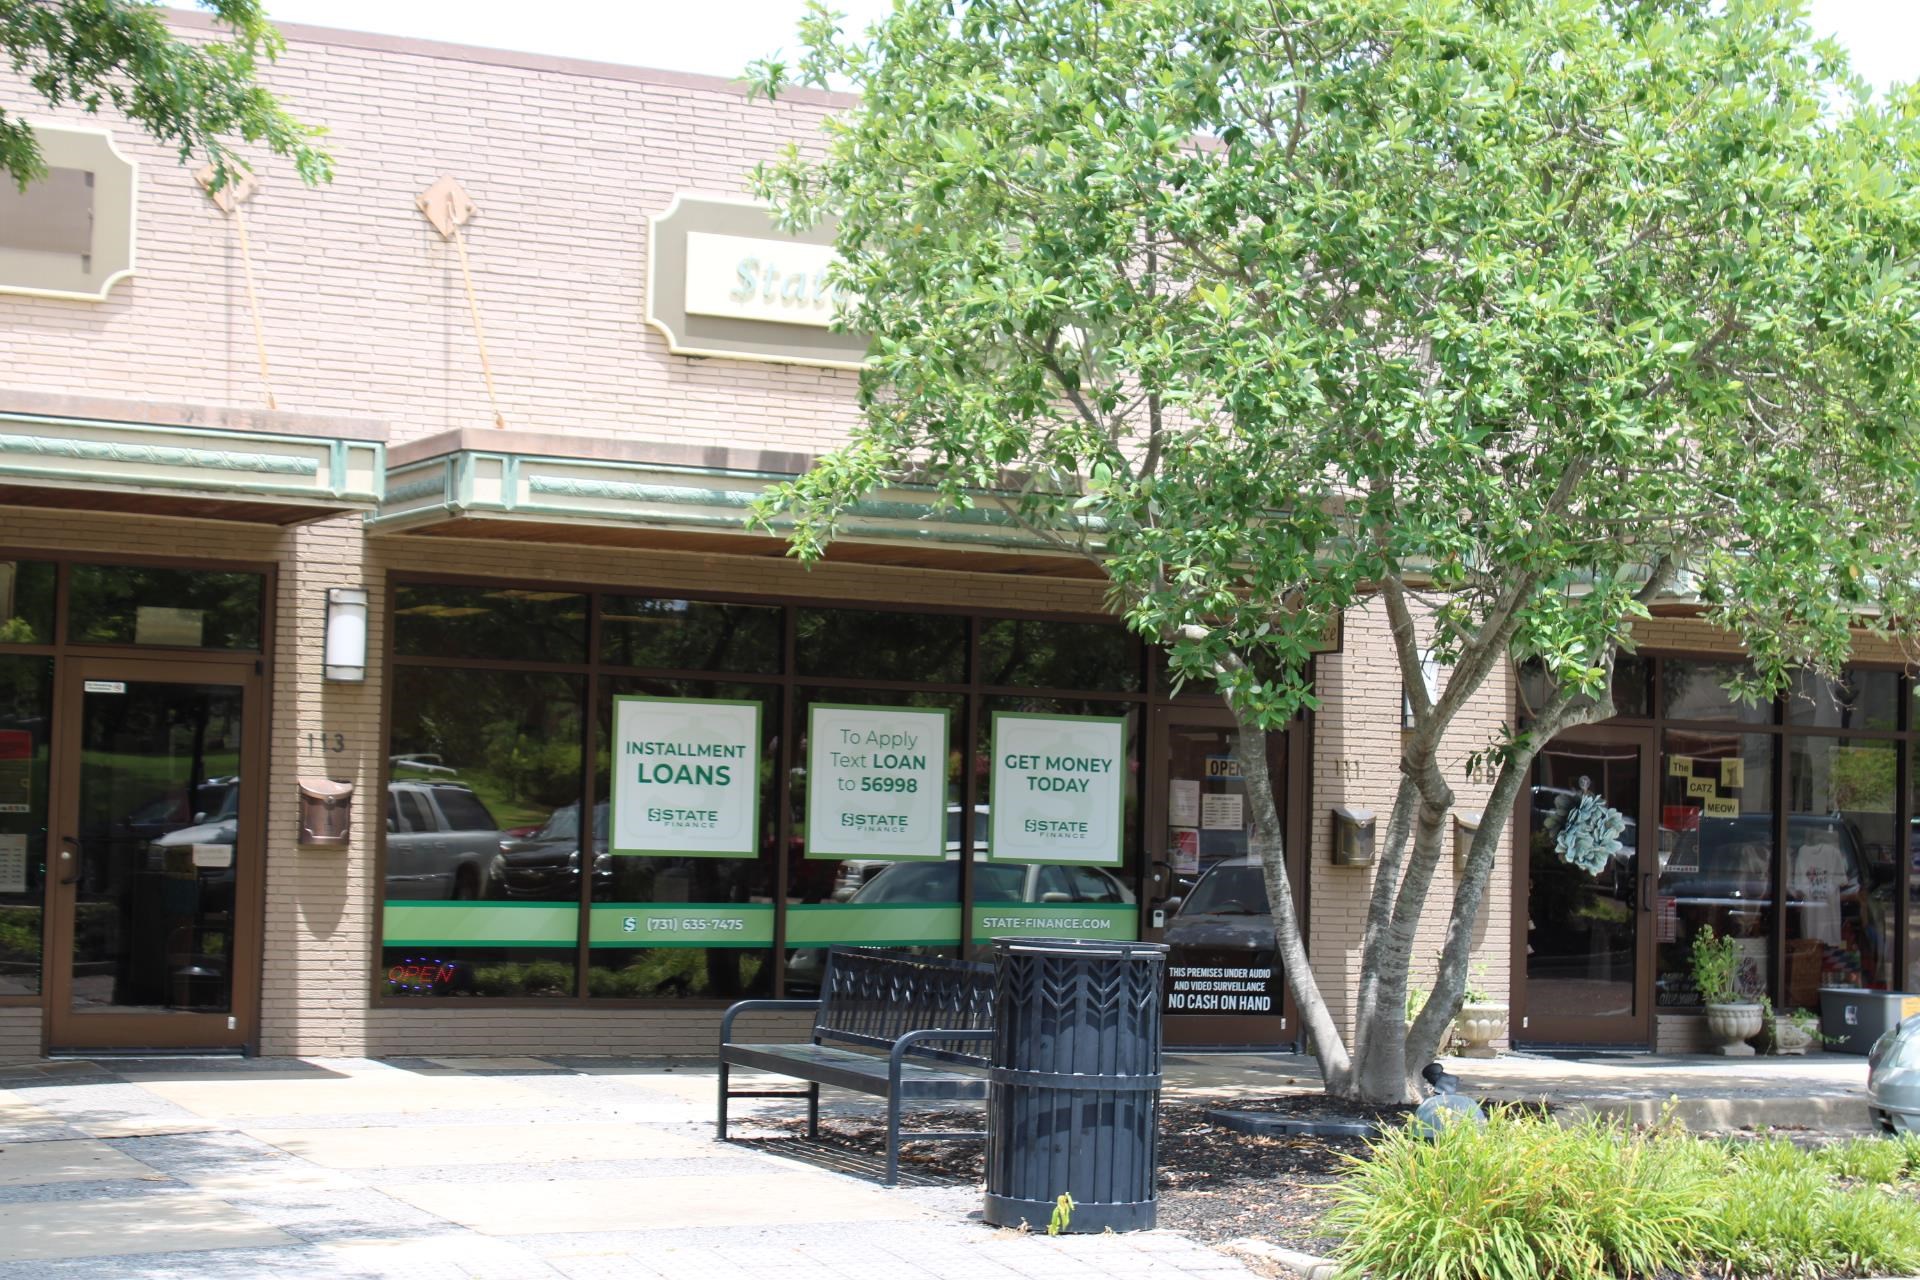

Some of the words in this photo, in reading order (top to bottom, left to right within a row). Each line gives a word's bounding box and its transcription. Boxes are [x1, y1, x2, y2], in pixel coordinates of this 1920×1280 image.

[308, 733, 344, 753] 113
[840, 728, 861, 745] To
[865, 730, 918, 750] Apply
[626, 741, 746, 758] INSTALLMENT
[830, 751, 867, 768] Text
[873, 754, 926, 770] LOAN
[1005, 754, 1040, 770] GET
[1046, 756, 1112, 773] MONEY
[1673, 762, 1689, 773] The
[637, 763, 731, 786] LOANS
[838, 778, 856, 791] to
[861, 777, 918, 793] 56998
[1027, 776, 1090, 792] TODAY
[1689, 783, 1713, 793] CATZ
[663, 809, 718, 821] STATE
[1707, 803, 1736, 813] MEOW
[855, 814, 908, 826] STATE
[1038, 820, 1088, 832] STATE
[647, 918, 678, 931] (731)
[682, 918, 744, 931] 635-7475
[983, 917, 1111, 929] STATE-FINANCE.COM
[388, 965, 455, 984] OPEN
[1168, 967, 1186, 977] THIS
[1187, 967, 1223, 978] PREMISES
[1224, 968, 1248, 978] UNDER
[1249, 969, 1271, 979] AUDIO
[1174, 981, 1189, 991] AND
[1191, 981, 1212, 991] VIDEO
[1213, 982, 1266, 992] SURVEILLANCE
[1168, 993, 1185, 1009] NO
[1187, 994, 1218, 1010] CASH
[1221, 995, 1238, 1010] ON
[1239, 996, 1271, 1011] HAND
